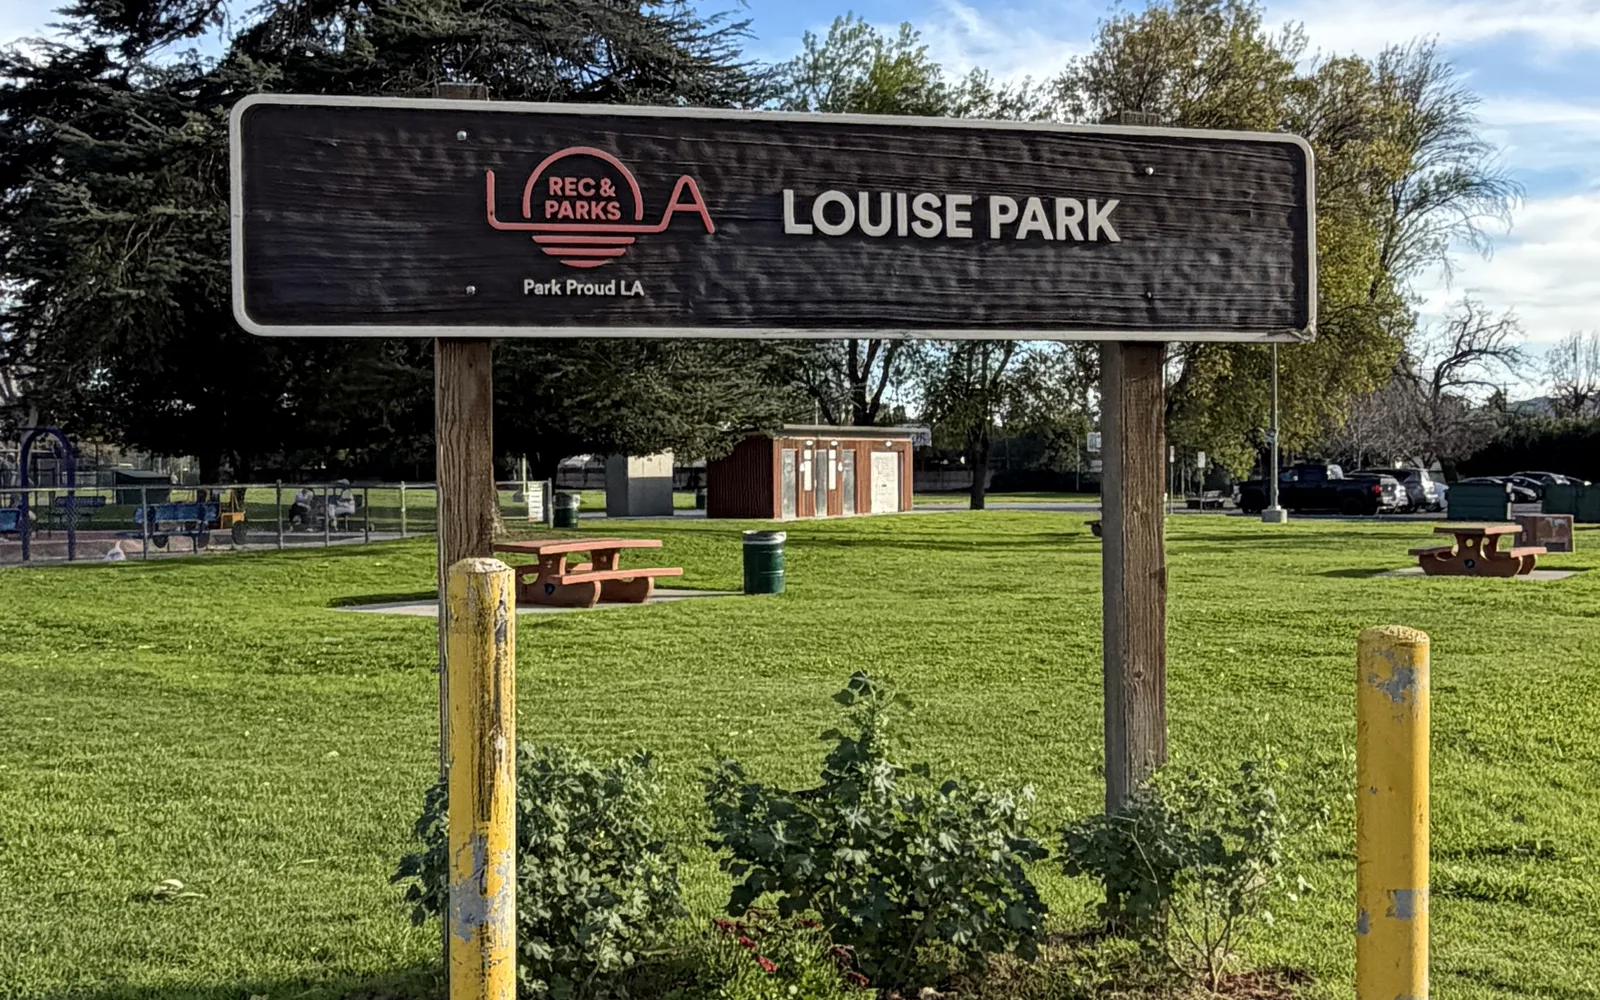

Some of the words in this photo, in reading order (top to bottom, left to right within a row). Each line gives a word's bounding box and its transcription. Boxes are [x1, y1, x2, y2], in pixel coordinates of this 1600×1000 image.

[549, 177, 596, 197] REC
[600, 178, 616, 197] &
[545, 200, 622, 220] PARKS
[783, 189, 973, 238] LOUISE
[989, 195, 1122, 242] PARK
[523, 279, 562, 295] Park
[566, 279, 616, 296] Proud
[620, 280, 645, 296] LA
